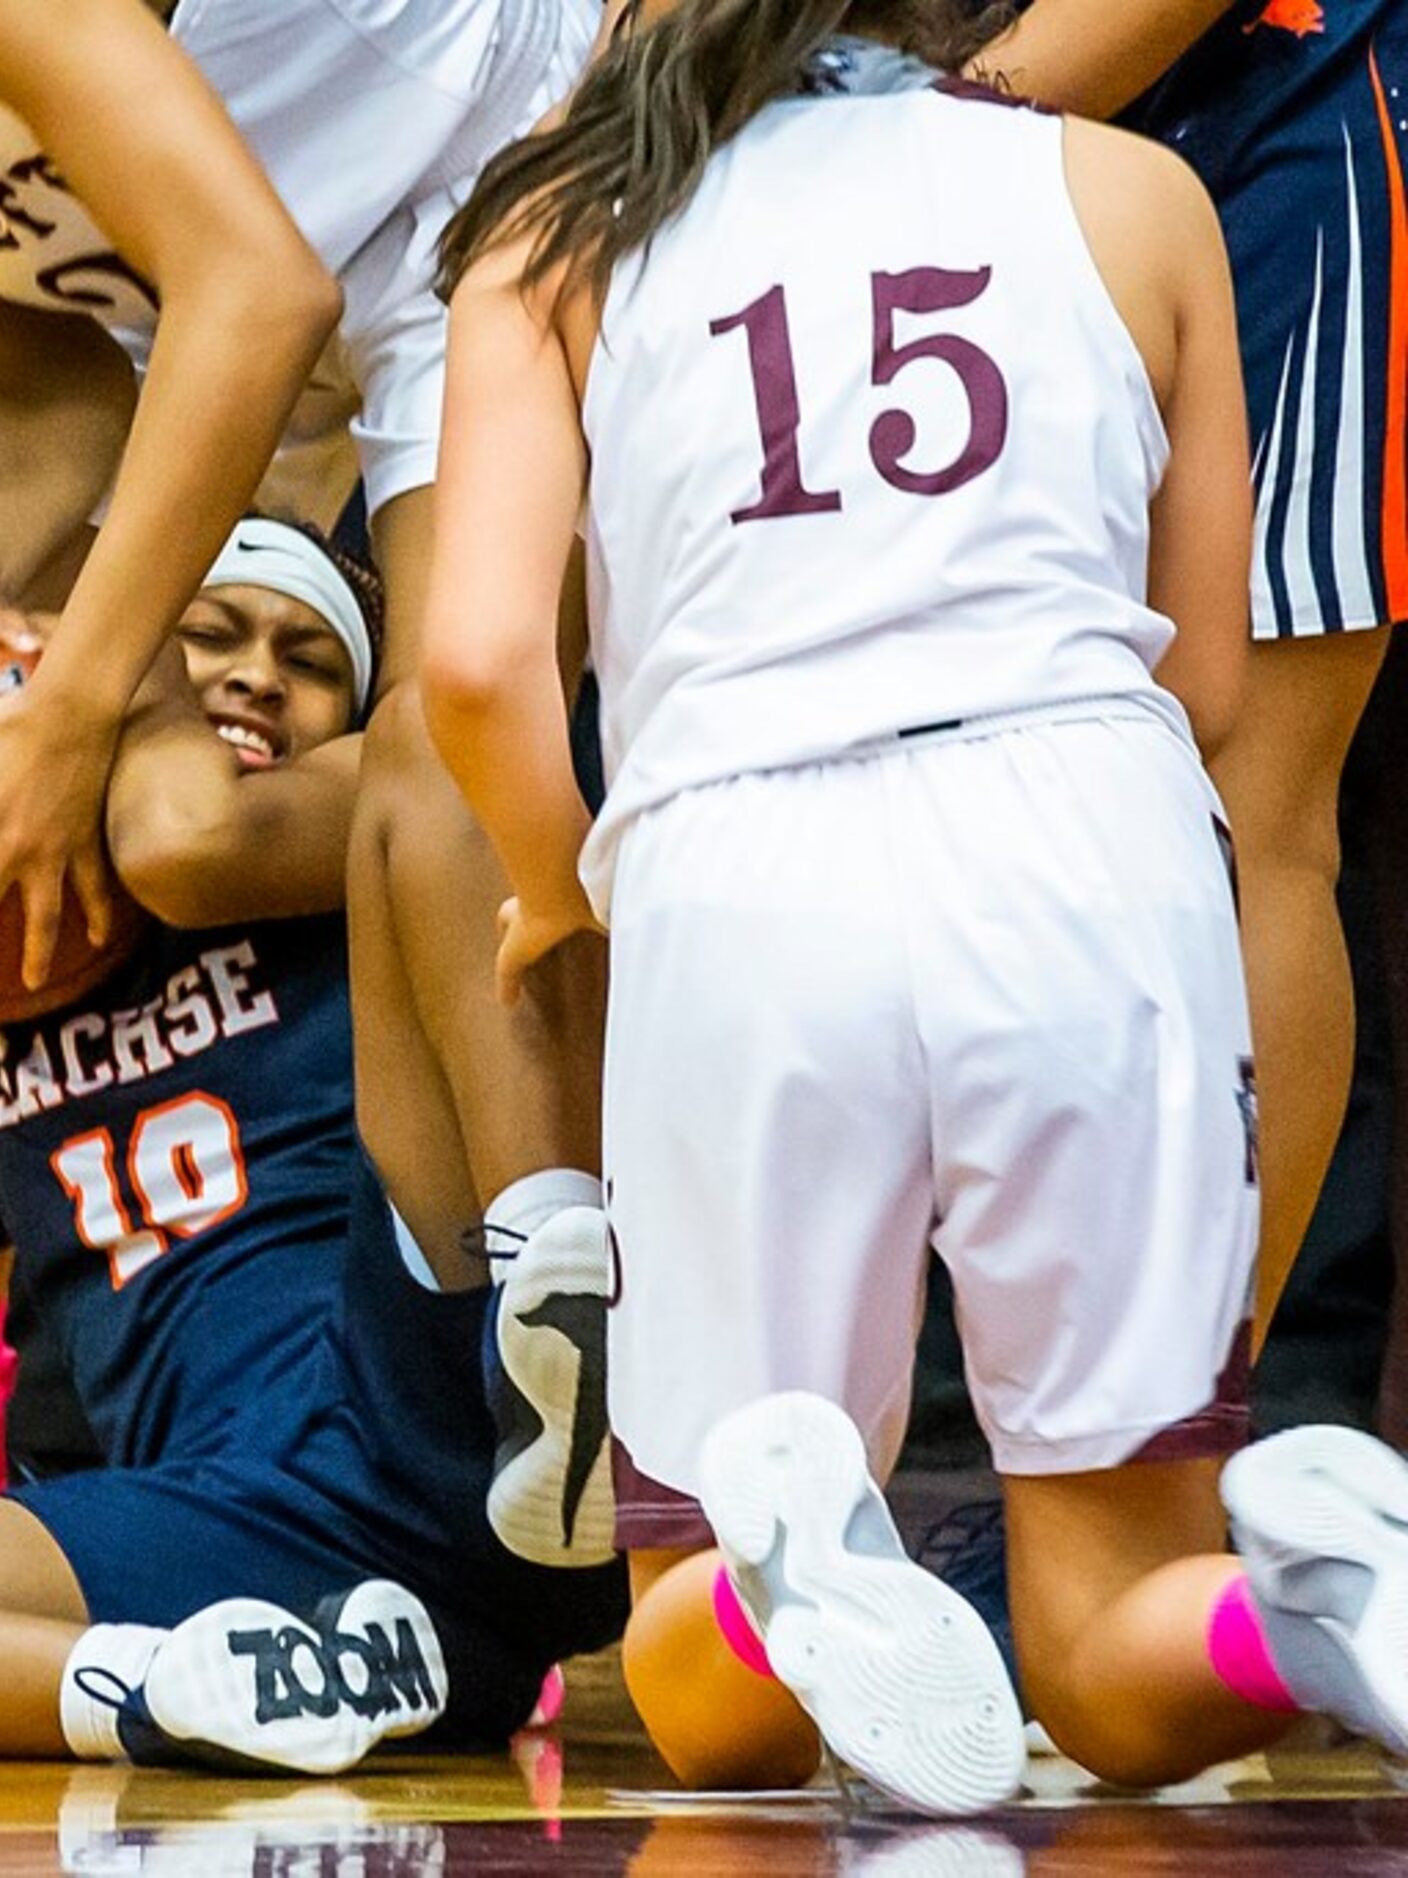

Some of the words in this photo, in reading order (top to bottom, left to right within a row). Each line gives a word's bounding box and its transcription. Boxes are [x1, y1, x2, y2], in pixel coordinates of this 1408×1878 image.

[709, 264, 1008, 526] 15
[48, 1088, 249, 1291] 10
[227, 1618, 439, 1725] ZOOM
